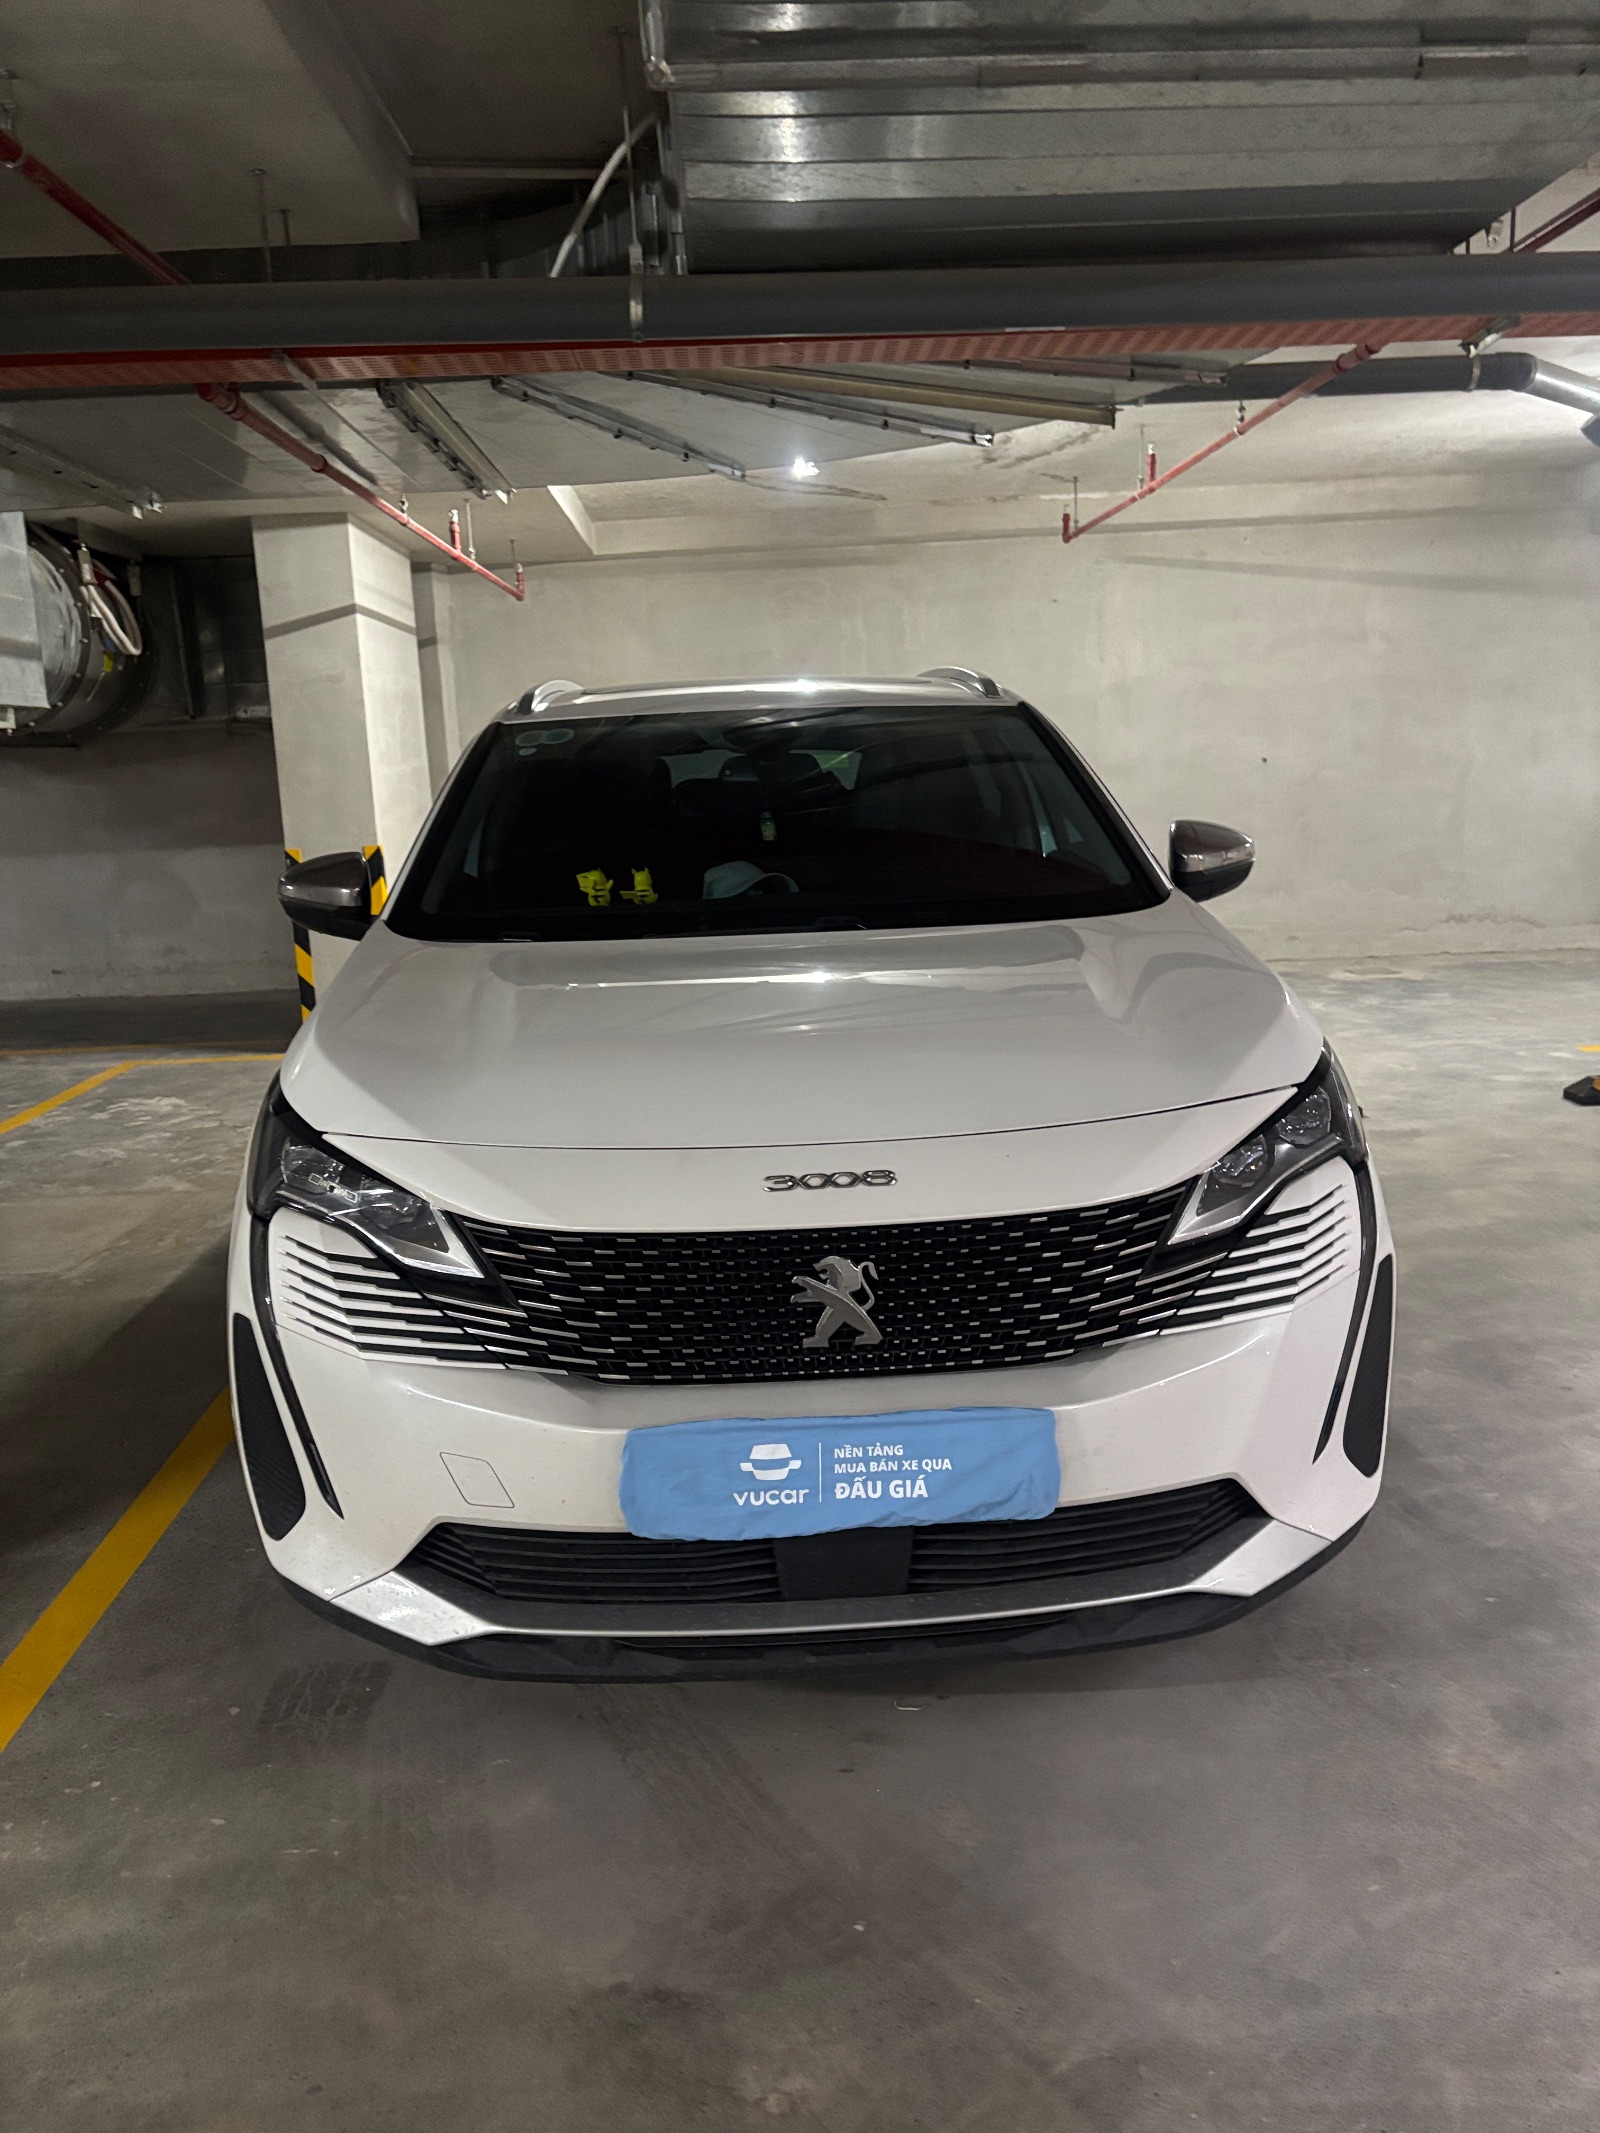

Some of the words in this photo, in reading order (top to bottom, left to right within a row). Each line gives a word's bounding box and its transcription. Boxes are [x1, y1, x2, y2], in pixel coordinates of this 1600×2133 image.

[763, 1169, 898, 1192] 3008
[834, 1444, 863, 1459] NỀN
[866, 1442, 904, 1457] TẢNG
[834, 1462, 867, 1474] MUA
[869, 1458, 898, 1472] BÁN
[901, 1460, 919, 1471] XE
[921, 1458, 953, 1473] QUA
[834, 1475, 882, 1500] ĐẤU
[888, 1474, 929, 1498] GIÁ
[732, 1488, 810, 1506] vucar
